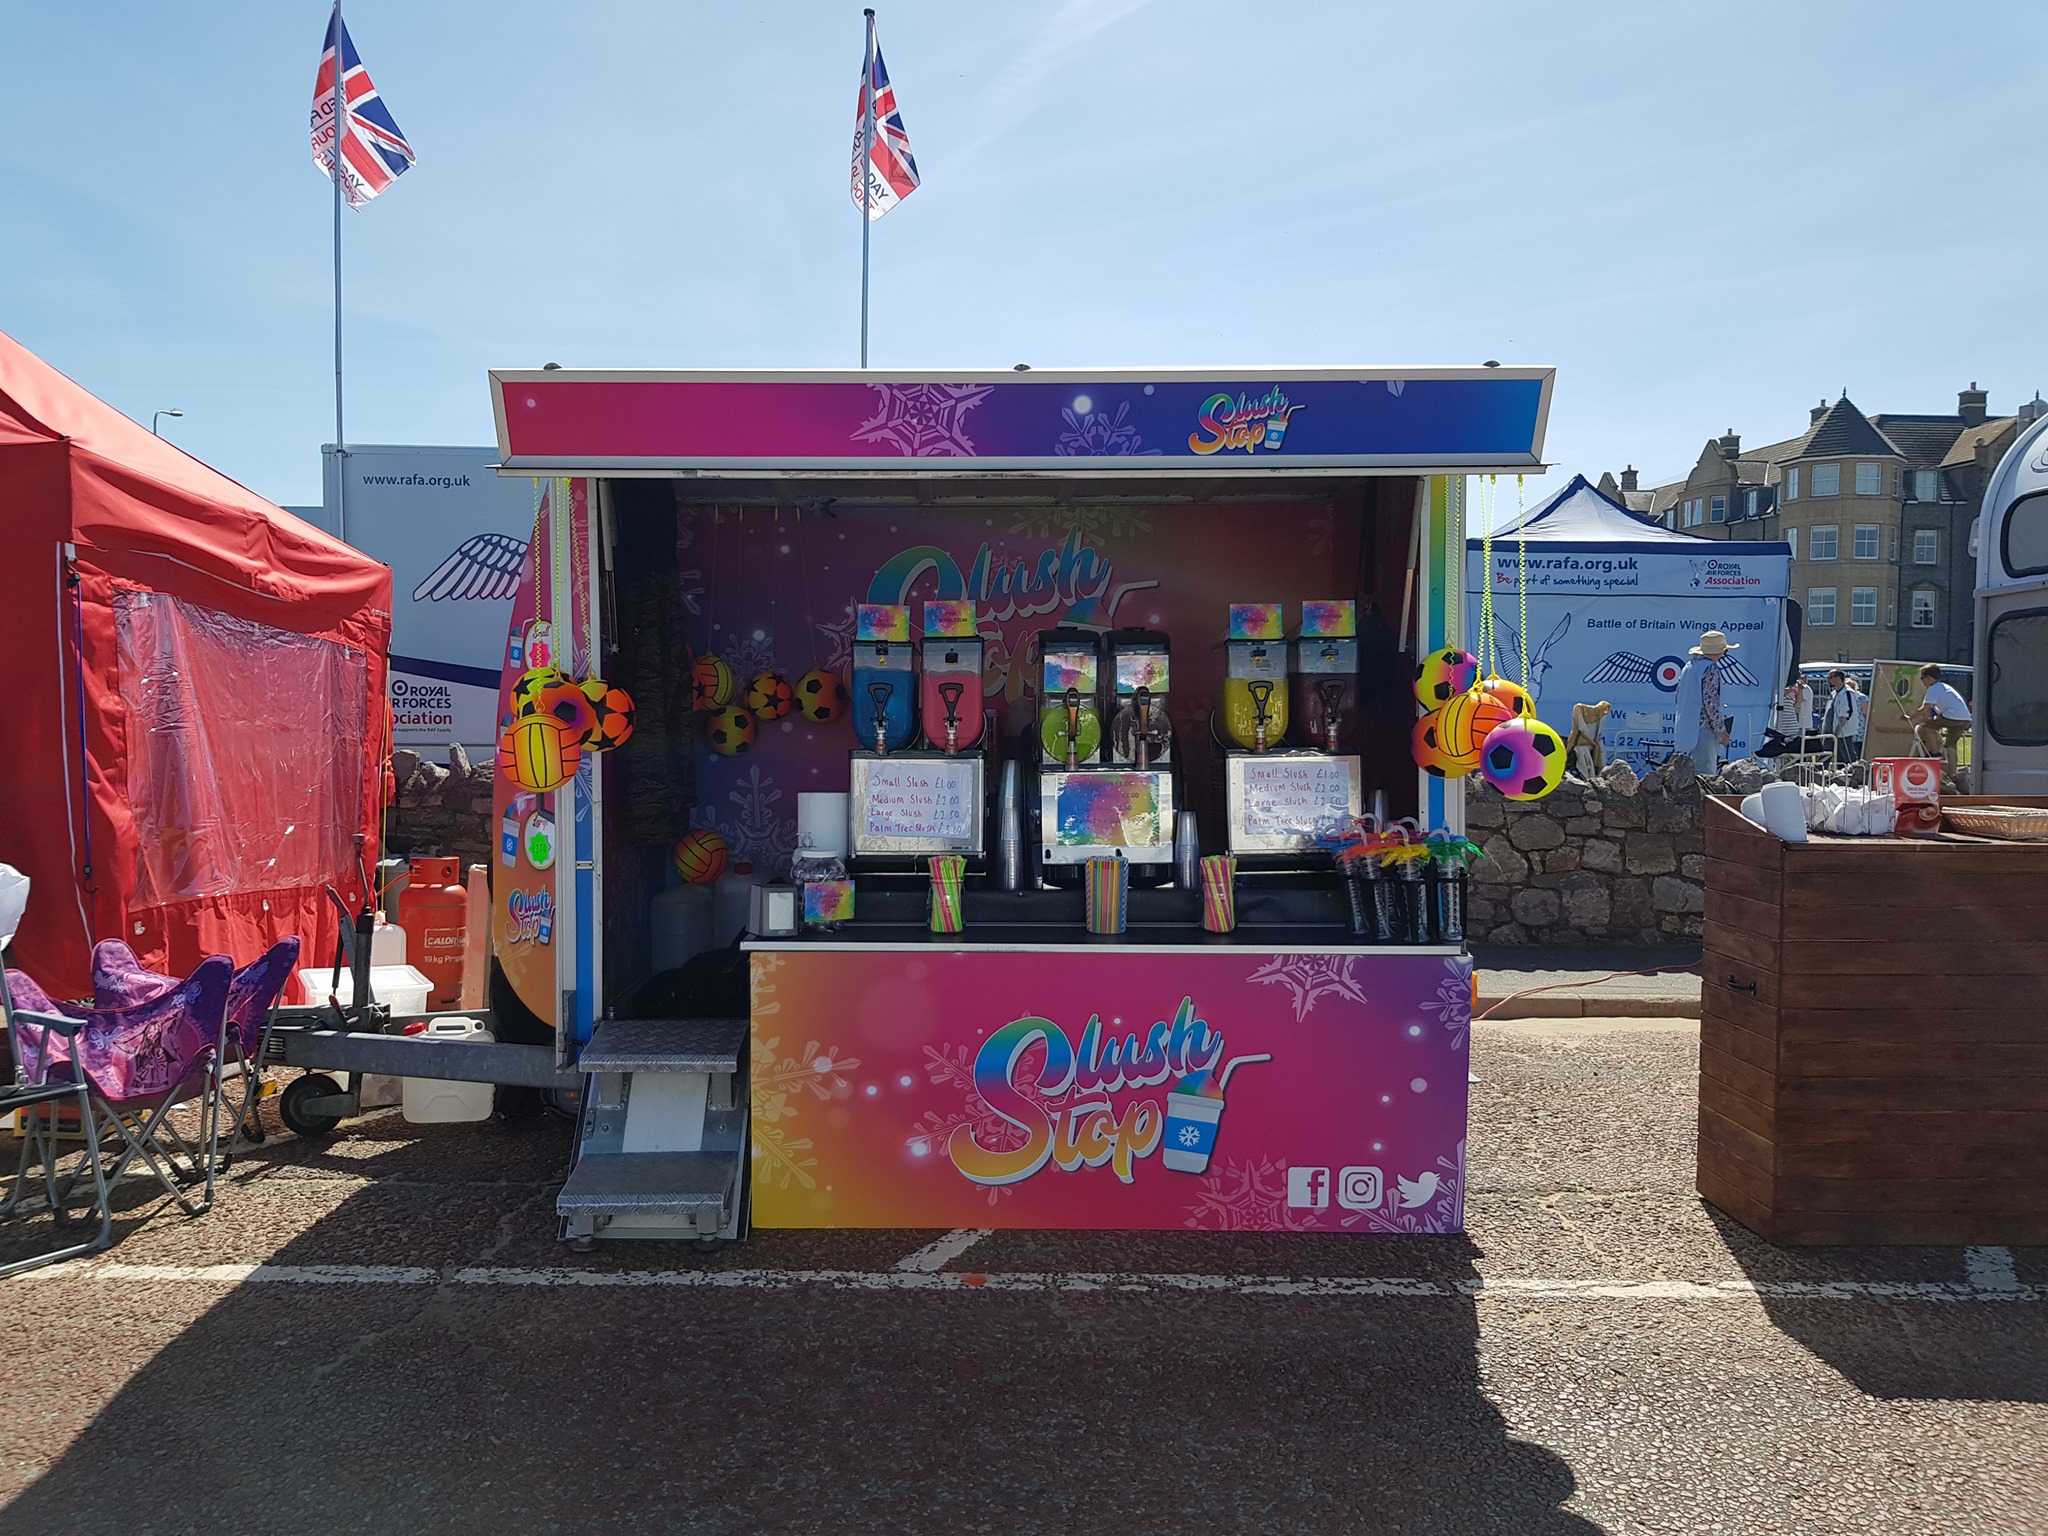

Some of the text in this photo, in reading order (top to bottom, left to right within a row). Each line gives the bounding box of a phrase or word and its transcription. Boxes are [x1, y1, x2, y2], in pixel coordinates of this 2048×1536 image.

[868, 172, 889, 201] DAY
[1190, 384, 1290, 428] Slush
[1188, 413, 1266, 455] Stop
[363, 473, 471, 489] www.rafa.org.uk
[1497, 556, 1639, 573] www.rafa.org.uk
[867, 523, 1112, 622] Slush
[1496, 572, 1512, 584] Be
[1540, 574, 1551, 586] of
[1553, 574, 1601, 590] something
[1603, 573, 1639, 590] special
[1705, 576, 1760, 585] Association
[1587, 619, 1764, 632] Battle of Britain Wings Appeal
[410, 686, 451, 697] ROYAL
[402, 698, 452, 709] FORCES
[393, 710, 453, 725] ociation
[872, 772, 900, 787] Small
[907, 776, 929, 788] Slush
[1250, 768, 1278, 780] Small
[1283, 768, 1308, 780] Slush
[1249, 784, 1286, 793] Medium
[1290, 782, 1312, 792] Slush
[871, 794, 904, 804] Medium
[910, 794, 933, 804] Slush
[1248, 799, 1278, 812] Large
[870, 808, 893, 821] Large
[900, 809, 922, 818] Slush
[1248, 814, 1271, 826] Palm
[1275, 816, 1292, 825] Tree
[869, 821, 892, 832] Palm
[895, 823, 912, 832] Tree
[915, 823, 936, 833] Slush
[427, 936, 457, 946] CALOR
[955, 996, 1225, 1110] Slush
[949, 1068, 1164, 1185] Stop
